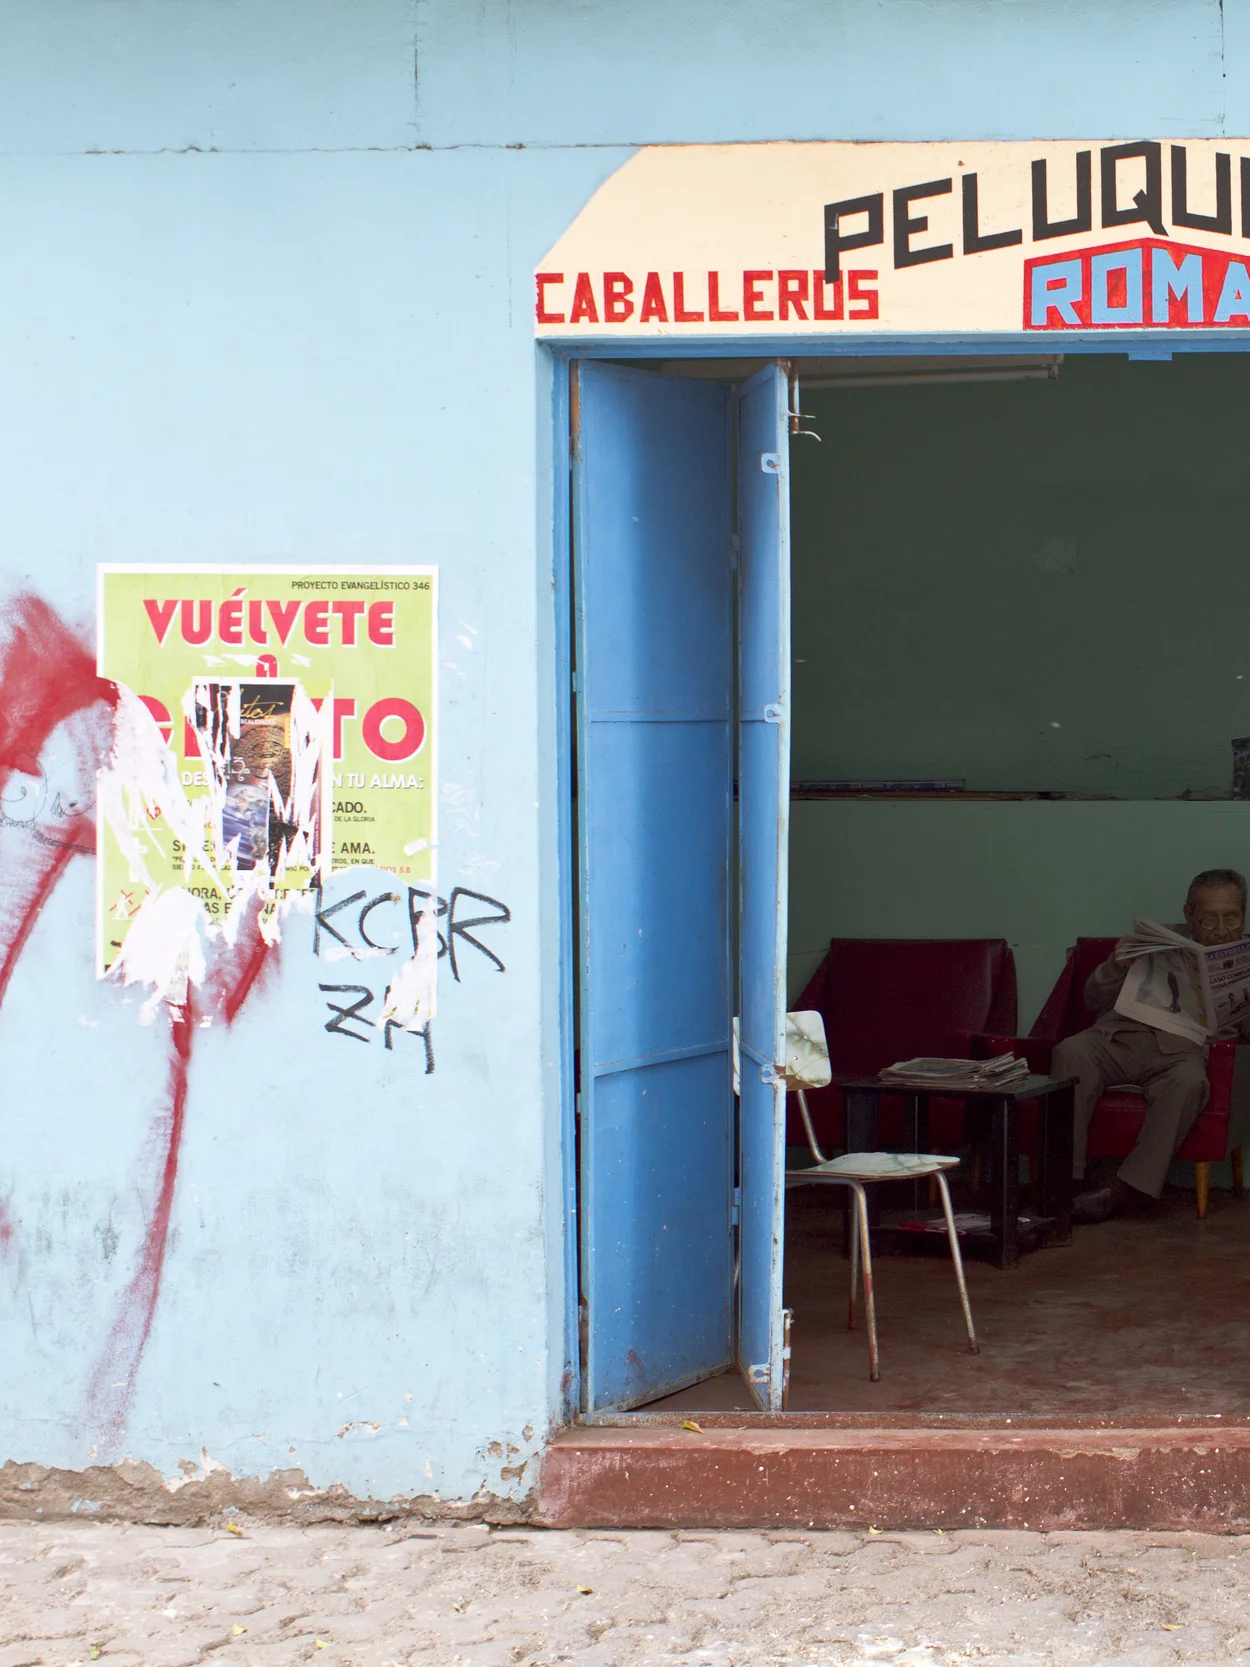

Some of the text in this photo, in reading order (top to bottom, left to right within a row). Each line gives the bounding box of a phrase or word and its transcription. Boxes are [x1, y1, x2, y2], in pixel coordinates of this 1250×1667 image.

[536, 270, 879, 323] CABALLEROS
[291, 580, 430, 590] PROYECTO EVANGELÍSTICO 346
[143, 587, 396, 647] VUÉLVETE
[347, 773, 365, 788] TU
[370, 773, 424, 789] ALMA:
[341, 842, 375, 854] AMA.
[361, 858, 375, 866] QUE
